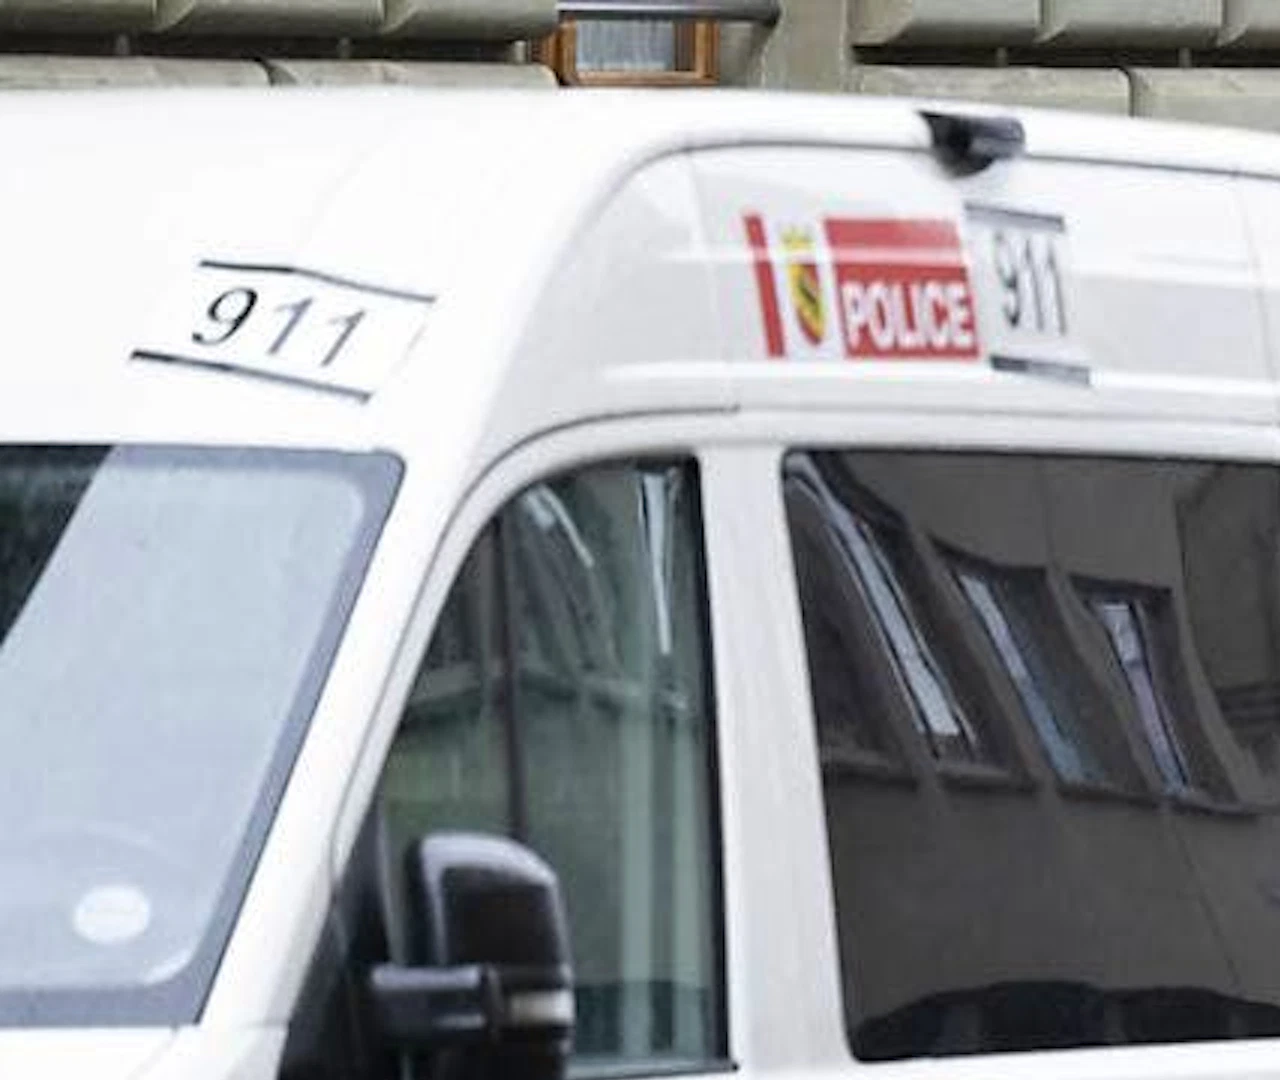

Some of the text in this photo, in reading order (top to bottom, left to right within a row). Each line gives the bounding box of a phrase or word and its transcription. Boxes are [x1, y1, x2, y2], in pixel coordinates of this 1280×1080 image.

[841, 279, 975, 350] POLICE
[991, 231, 1067, 336] 911
[191, 287, 366, 368] 911
